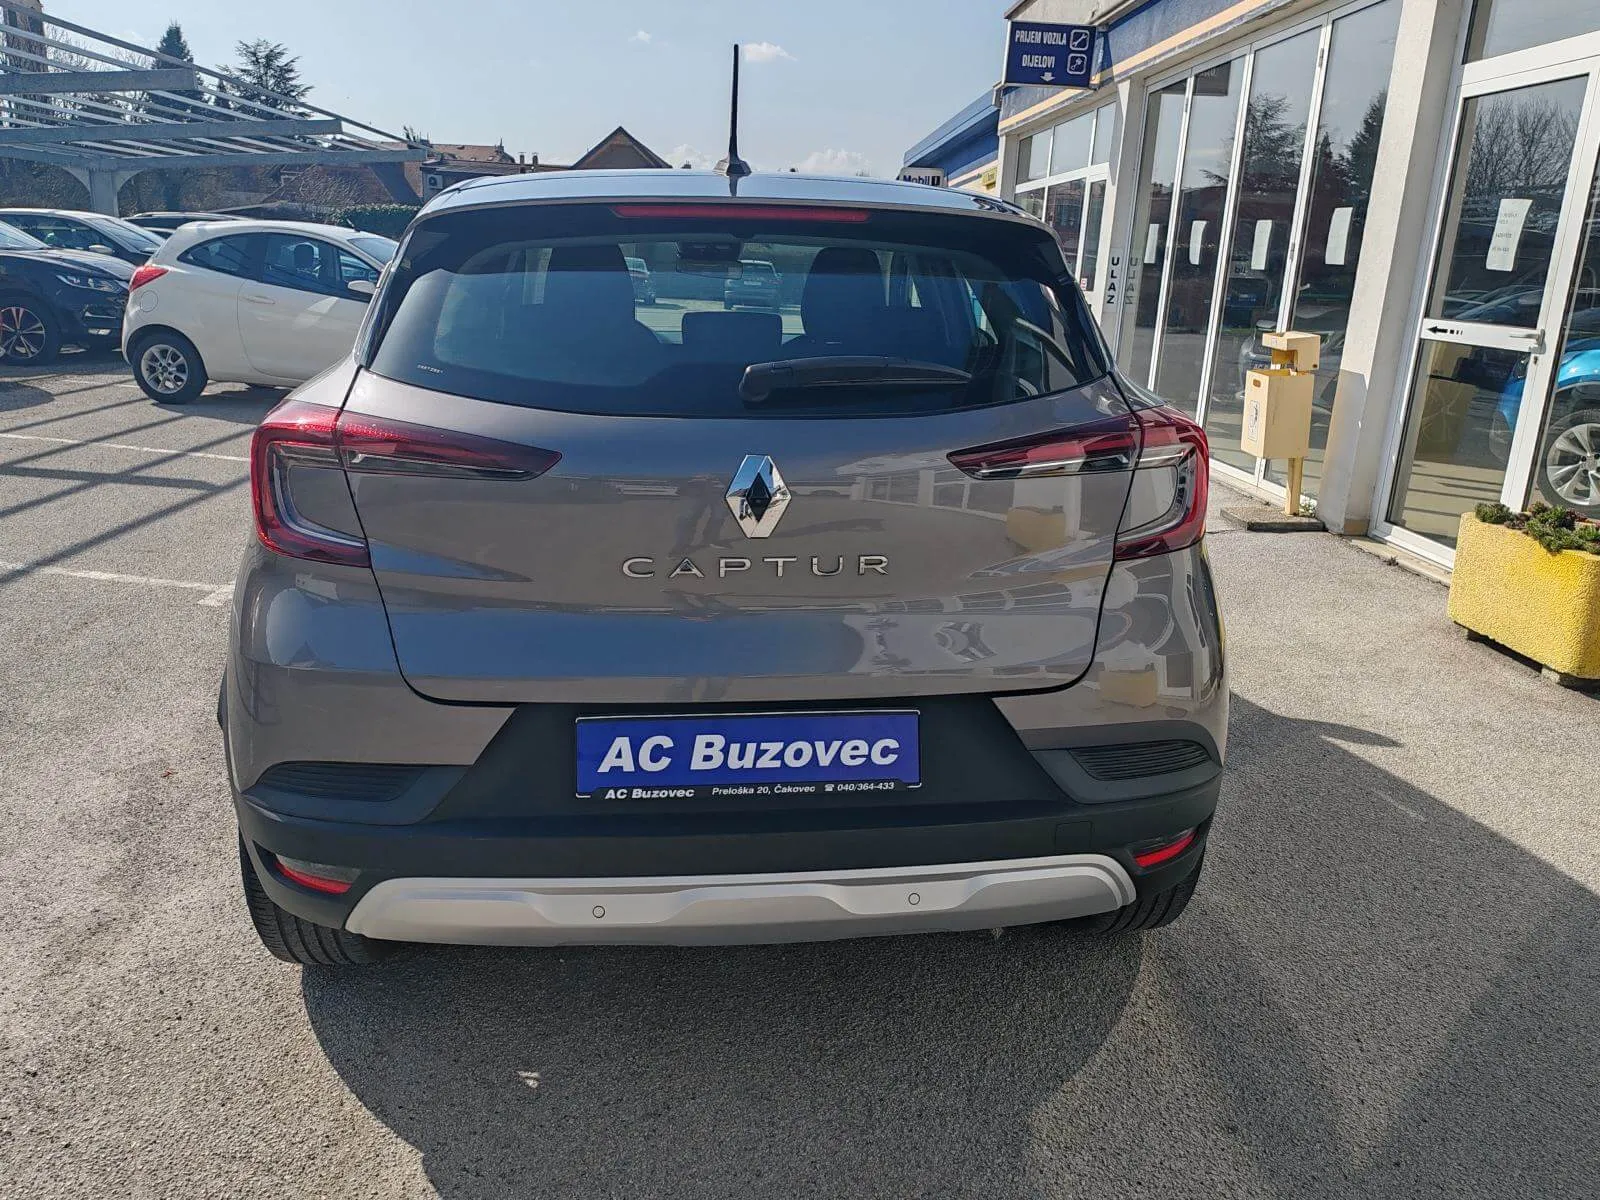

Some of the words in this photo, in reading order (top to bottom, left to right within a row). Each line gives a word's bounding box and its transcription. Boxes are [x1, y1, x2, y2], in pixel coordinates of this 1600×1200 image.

[1015, 30, 1041, 44] PRIJEM
[1043, 32, 1067, 46] VOZILA
[1022, 54, 1055, 68] DIJELOVI
[1106, 256, 1120, 304] ULAZ
[622, 555, 889, 578] CAPTUR
[597, 735, 674, 773] AC
[690, 734, 900, 771] Buzovec
[605, 788, 628, 800] AC
[631, 788, 695, 799] Buzovec
[712, 786, 754, 796] Preloška
[756, 785, 771, 795] 20,
[774, 784, 816, 794] Čakovec
[837, 781, 895, 792] 040/364-433
